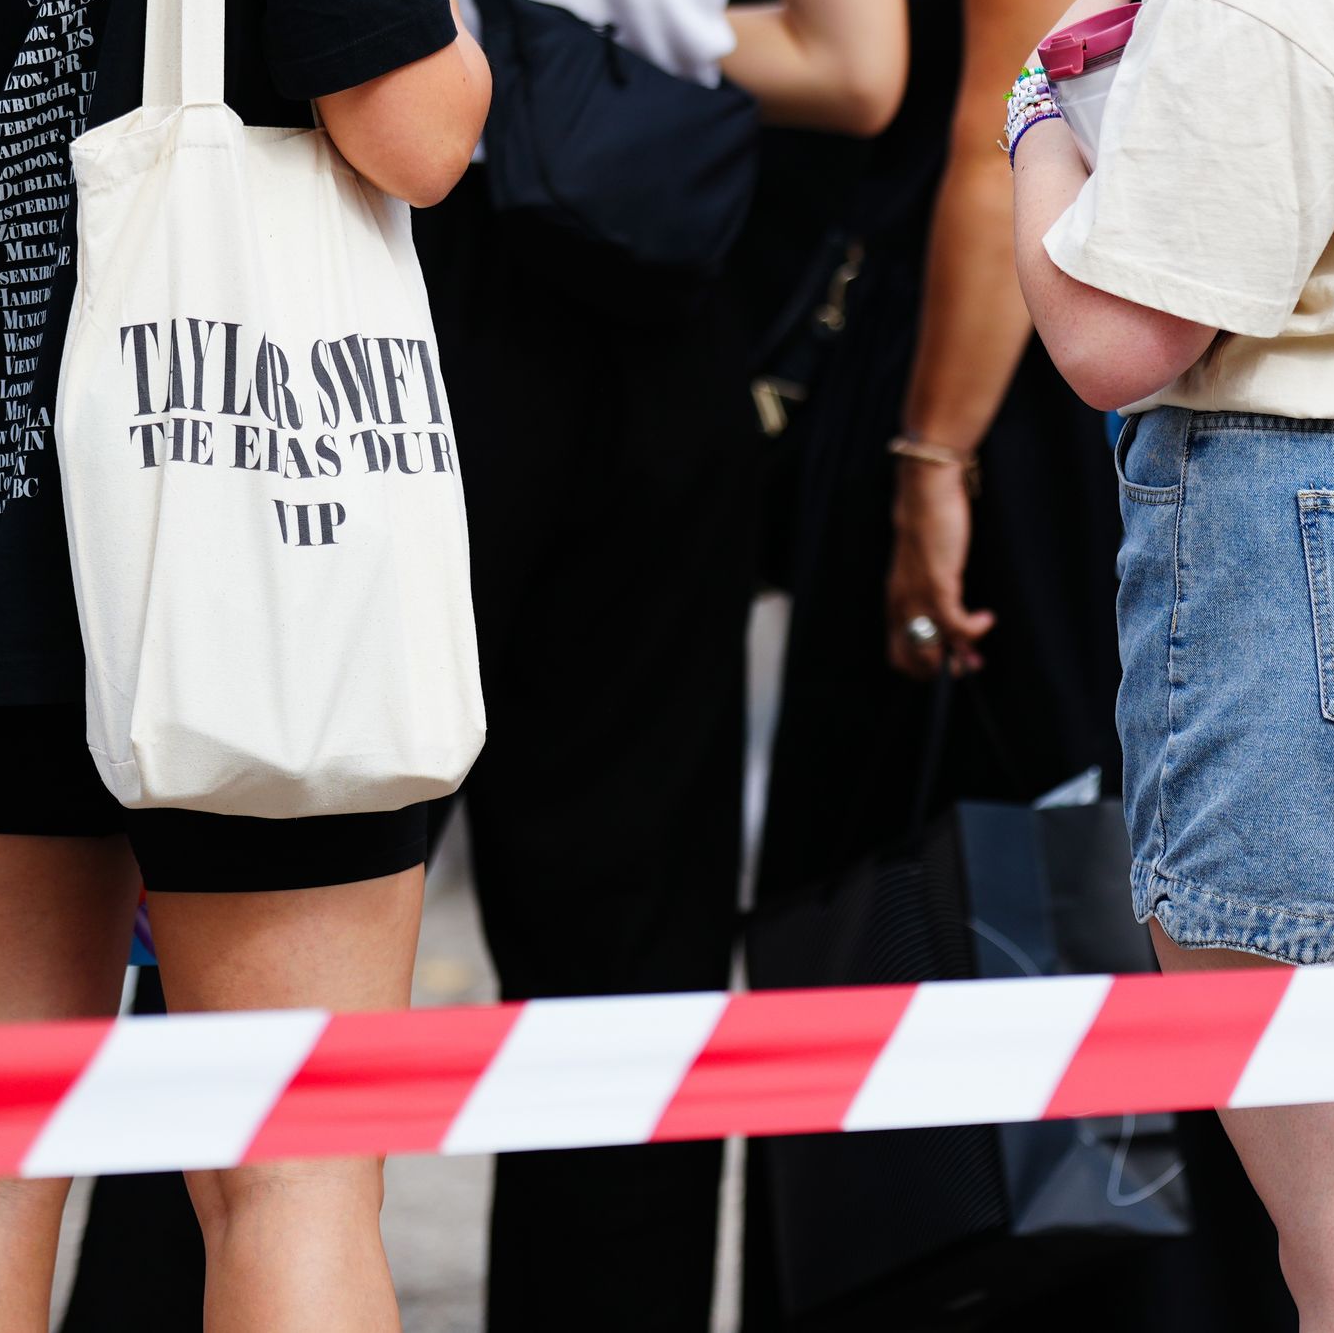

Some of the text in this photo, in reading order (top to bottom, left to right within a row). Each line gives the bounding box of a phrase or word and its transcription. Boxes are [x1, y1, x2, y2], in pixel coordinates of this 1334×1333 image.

[60, 7, 88, 34] PT
[66, 27, 94, 52] ES
[54, 53, 82, 79] FR
[120, 317, 304, 431] TAYLOR
[129, 417, 214, 469] THE
[12, 477, 39, 498] BC
